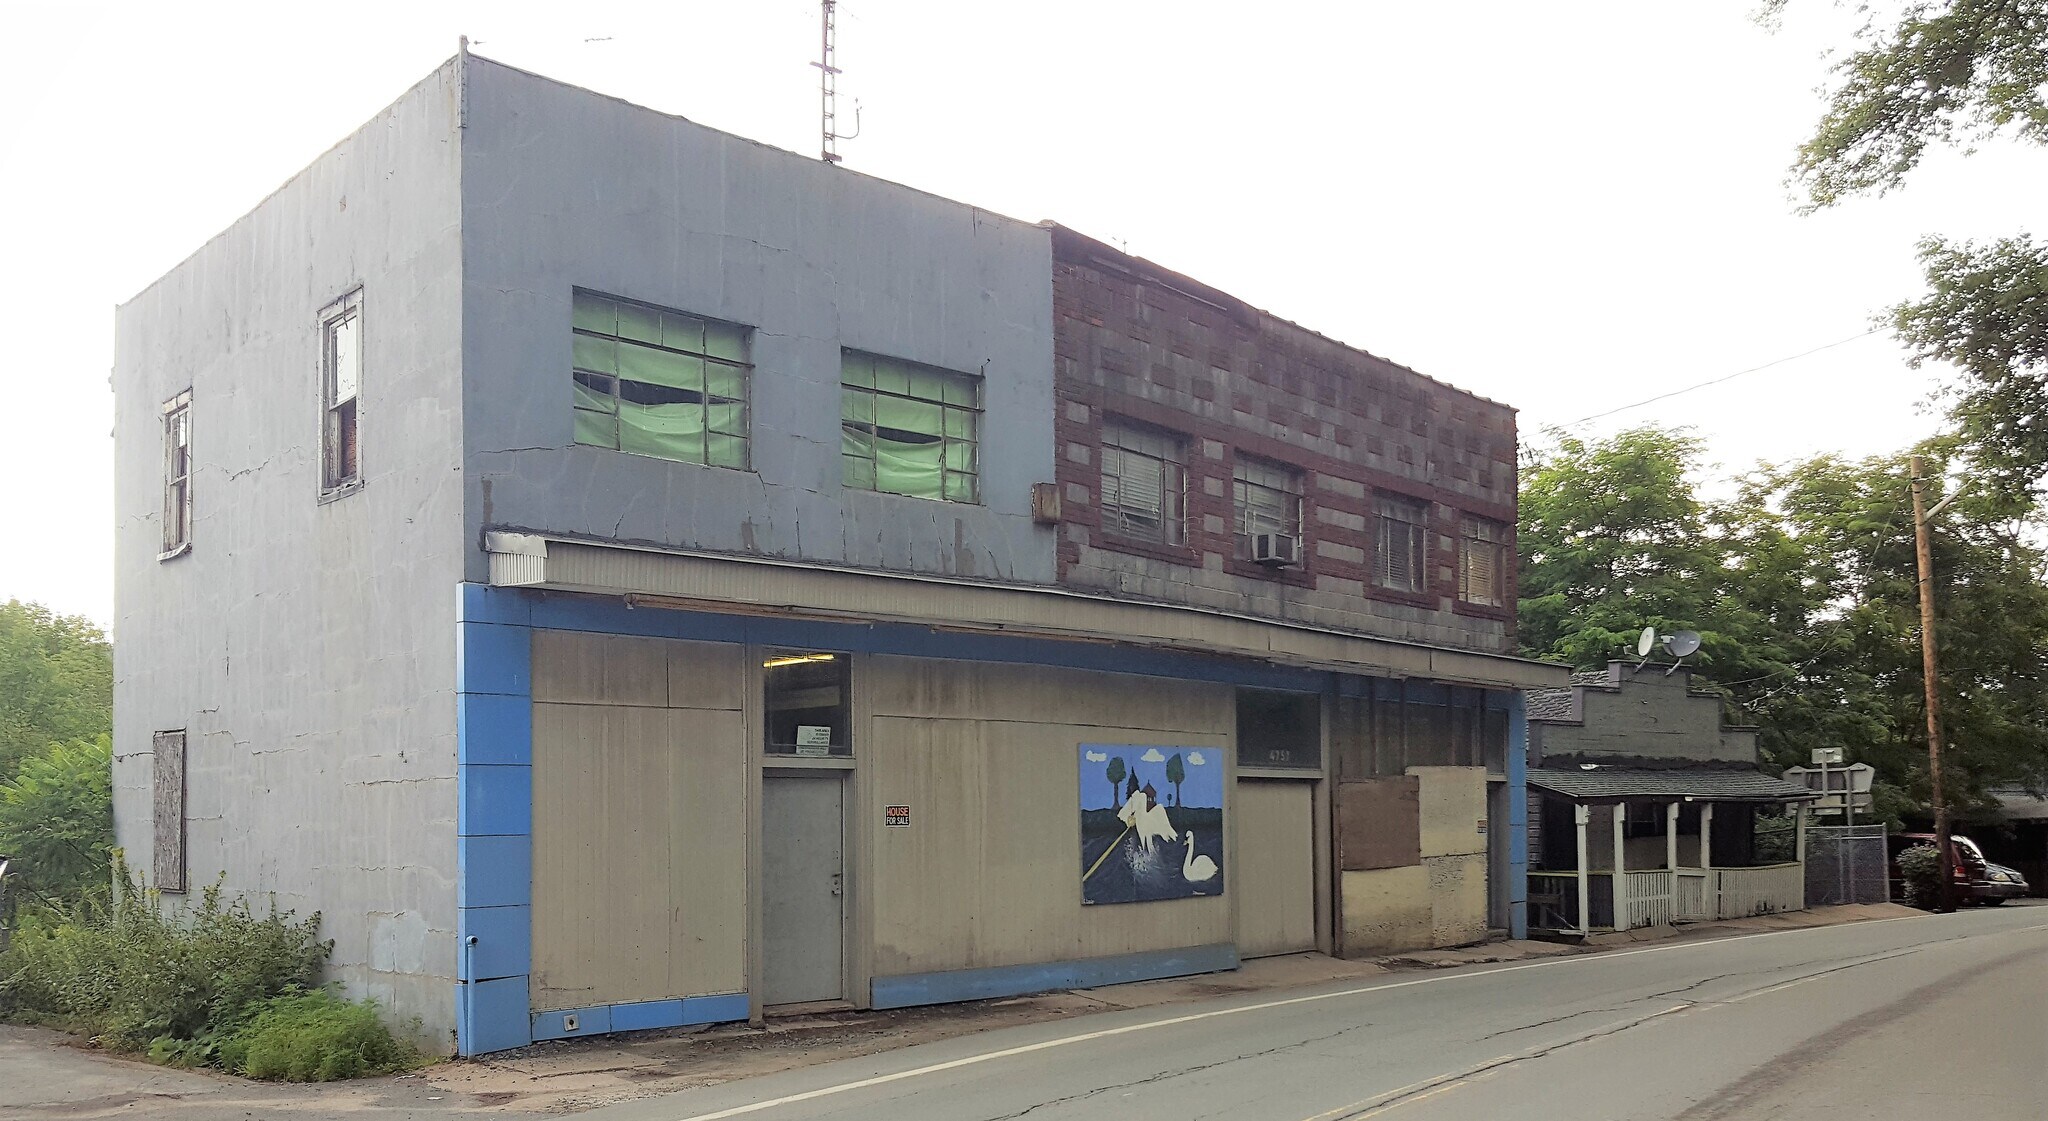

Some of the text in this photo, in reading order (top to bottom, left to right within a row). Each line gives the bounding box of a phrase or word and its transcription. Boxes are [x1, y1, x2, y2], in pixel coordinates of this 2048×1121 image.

[887, 807, 909, 816] HOUSE
[886, 816, 909, 825] FOR SALE
